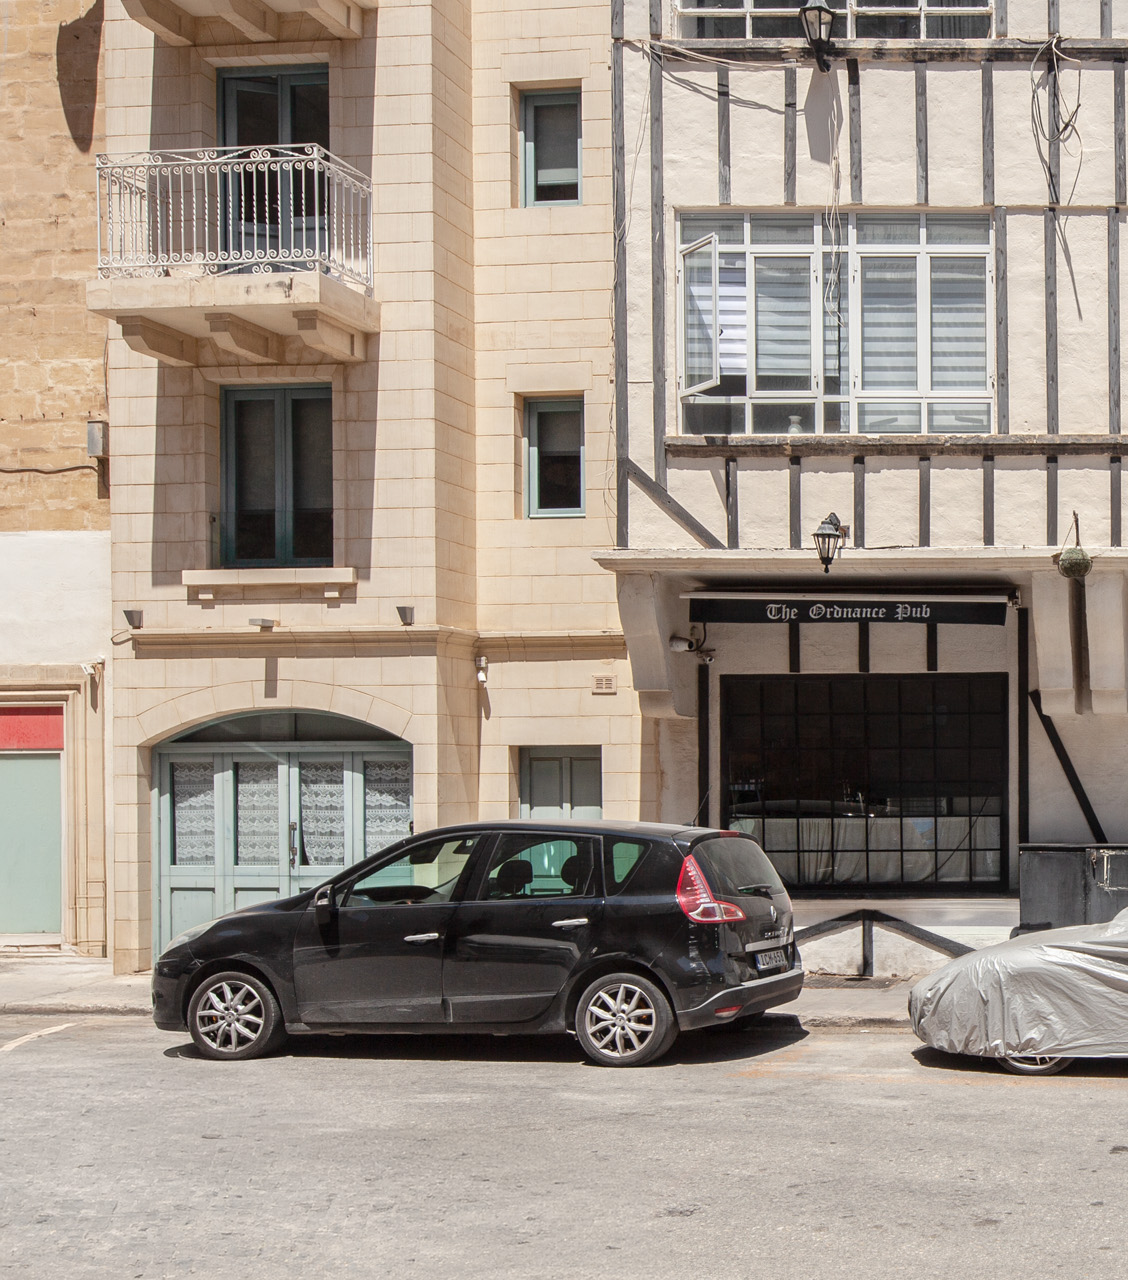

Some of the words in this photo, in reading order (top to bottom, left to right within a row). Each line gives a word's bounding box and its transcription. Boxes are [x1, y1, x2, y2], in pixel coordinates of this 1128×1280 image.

[766, 603, 798, 622] The
[809, 603, 887, 619] Ordnance
[894, 603, 931, 620] Pub
